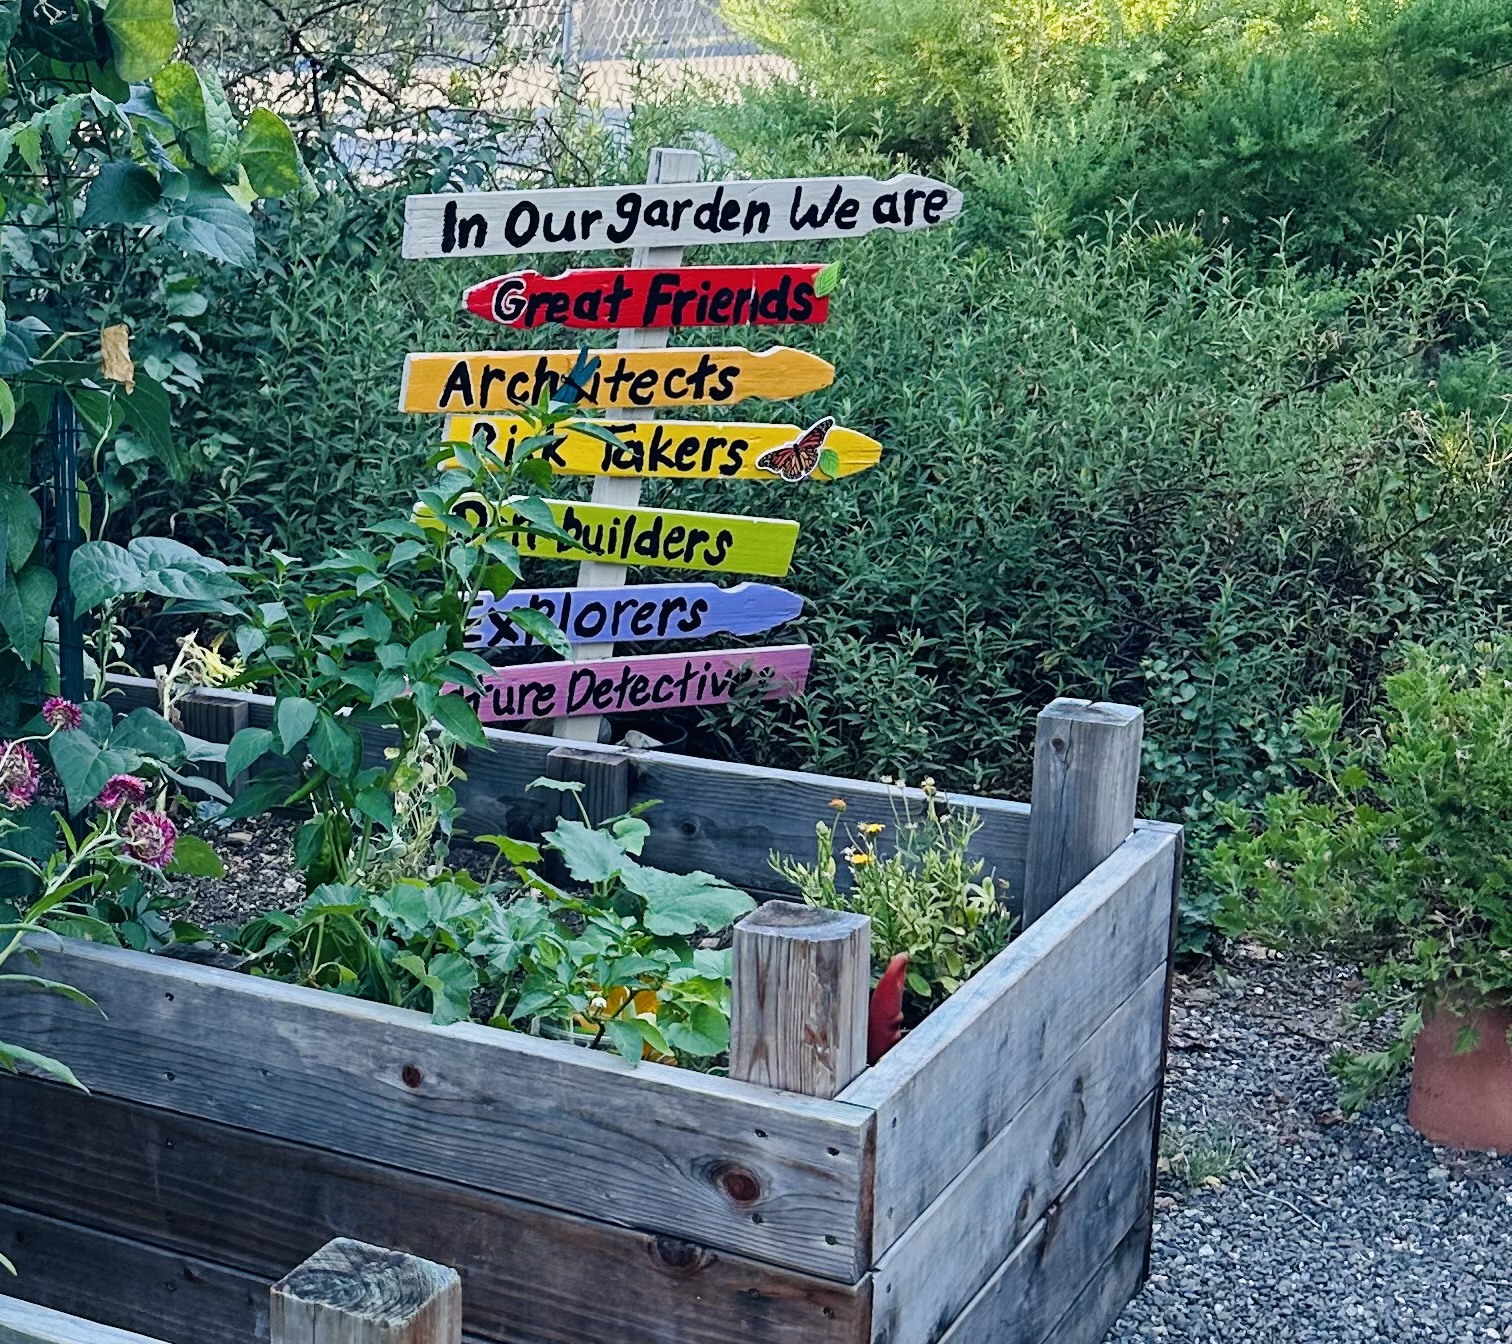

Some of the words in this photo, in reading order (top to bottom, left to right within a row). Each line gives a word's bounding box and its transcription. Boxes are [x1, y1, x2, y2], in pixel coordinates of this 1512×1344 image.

[441, 200, 488, 254] In
[504, 200, 602, 249] Our
[606, 185, 771, 244] garden
[789, 183, 861, 231] We
[872, 188, 949, 227] are
[493, 273, 633, 328] Great
[642, 272, 816, 327] Friends
[439, 353, 741, 408] Architects
[601, 423, 750, 476] Takers
[451, 500, 536, 551] Dn
[557, 506, 734, 567] builders
[463, 591, 709, 646] Explorers
